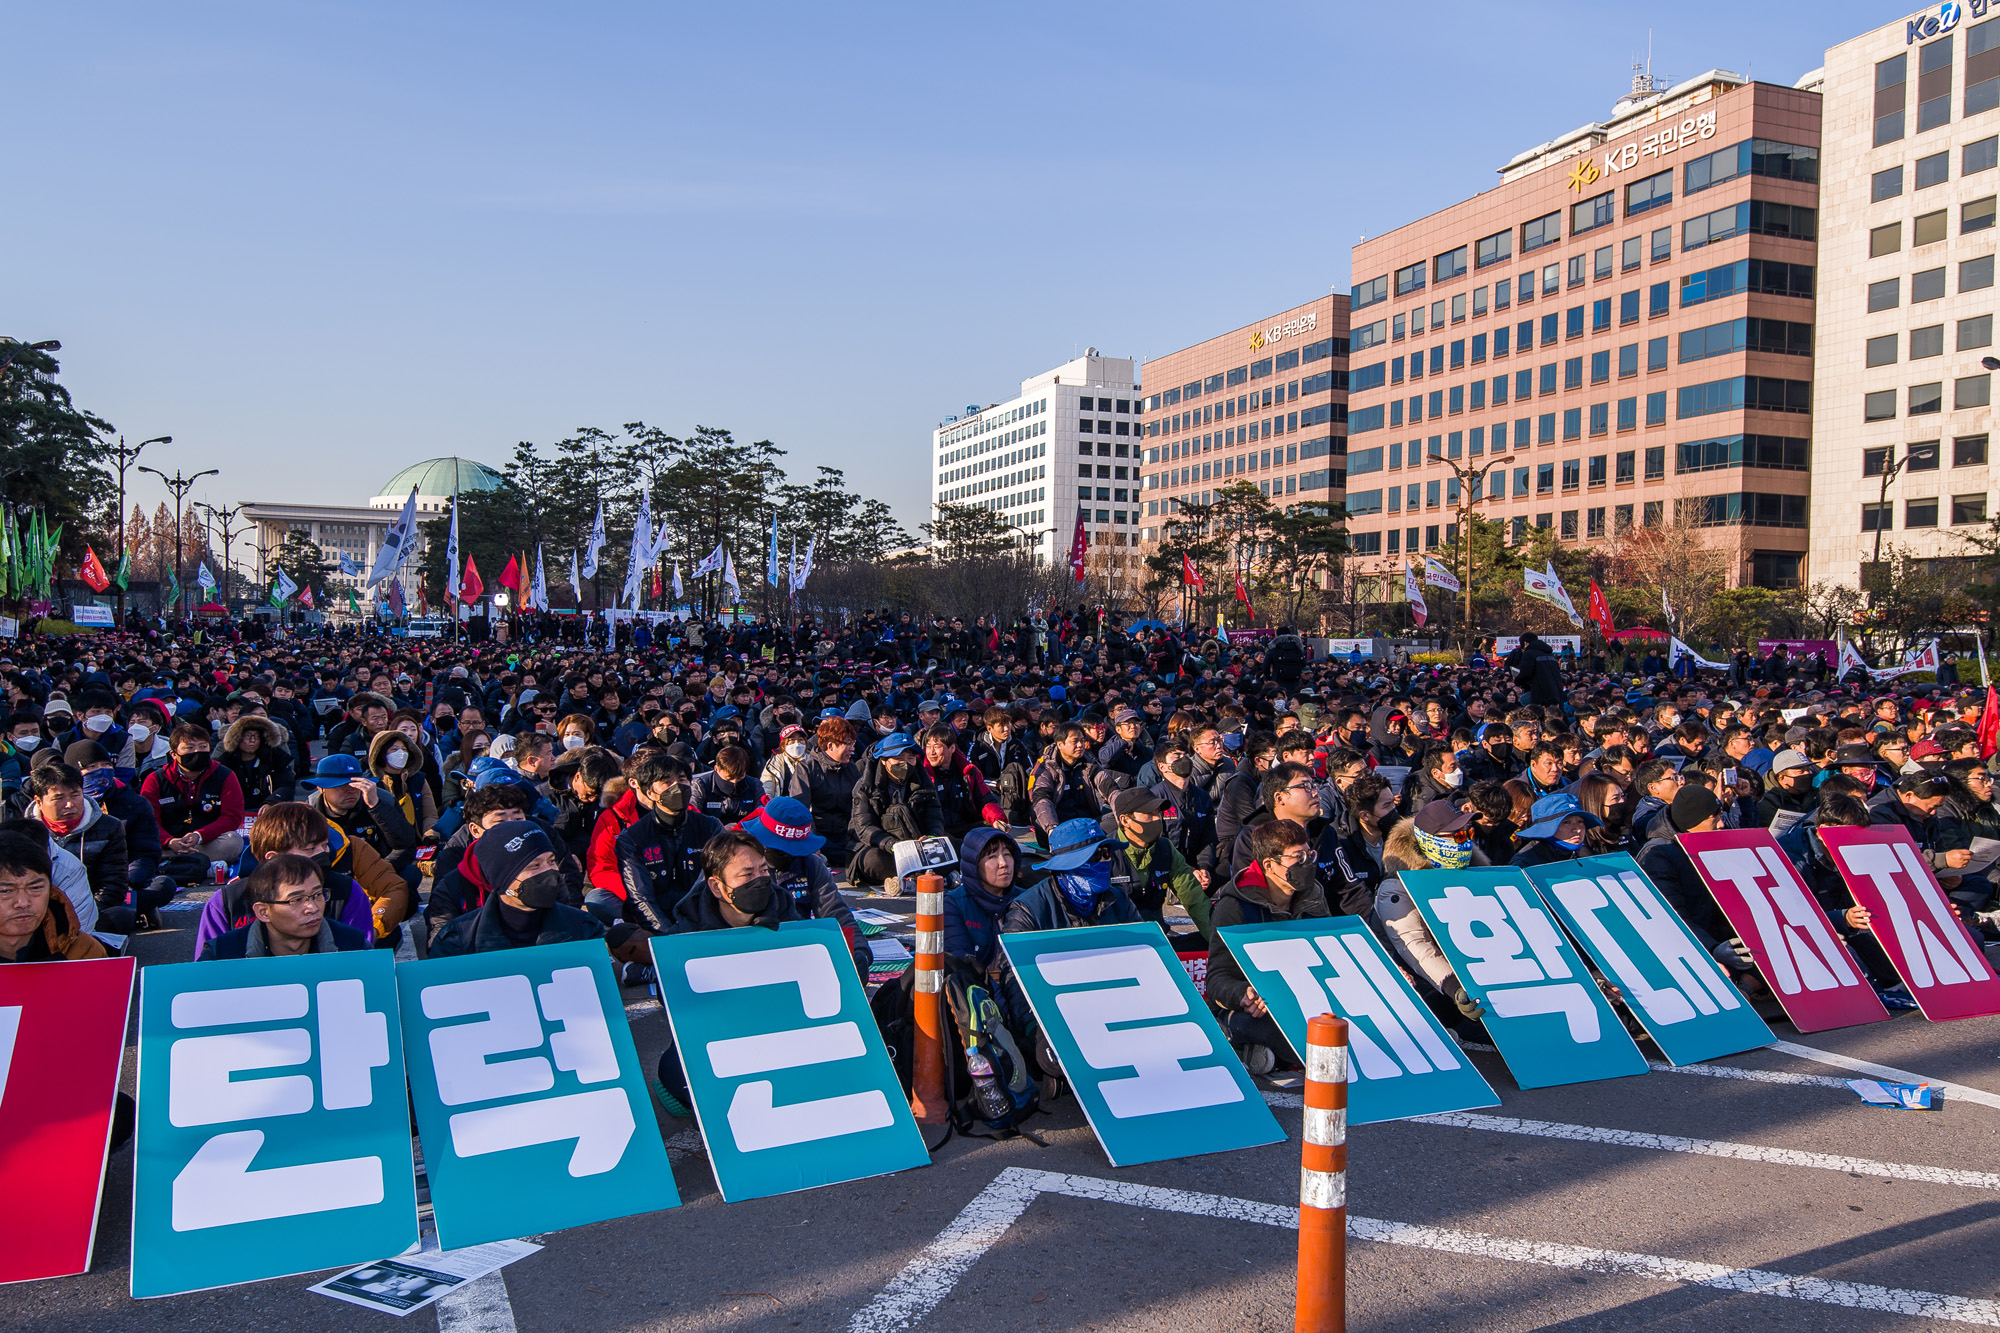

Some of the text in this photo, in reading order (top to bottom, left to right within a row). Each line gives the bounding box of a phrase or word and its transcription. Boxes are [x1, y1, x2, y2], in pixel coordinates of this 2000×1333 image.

[1428, 886, 1601, 1044] 확
[1551, 870, 1741, 1027] 대
[1698, 846, 1860, 995] 저
[1837, 842, 1991, 988] 지
[420, 966, 636, 1178] 력
[684, 943, 895, 1153] 근
[1034, 944, 1245, 1119] 로
[1243, 933, 1462, 1083] 제
[169, 978, 390, 1232] 탄
